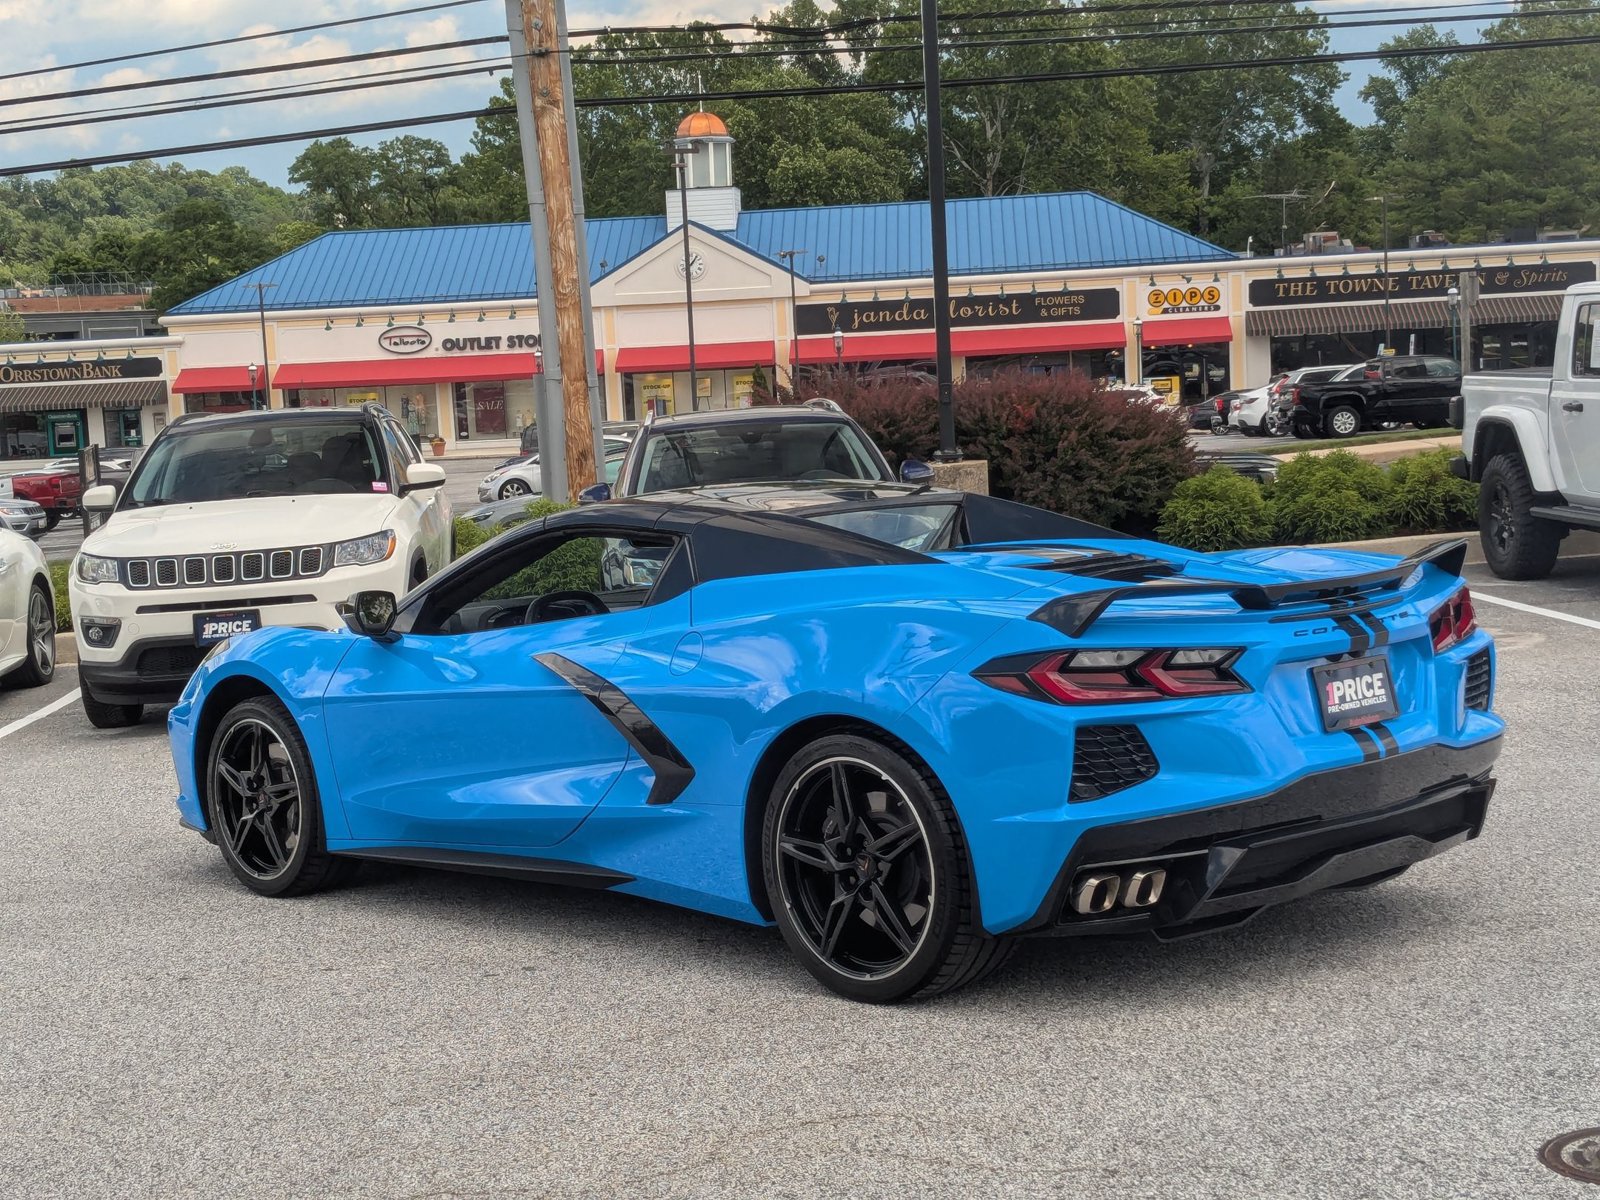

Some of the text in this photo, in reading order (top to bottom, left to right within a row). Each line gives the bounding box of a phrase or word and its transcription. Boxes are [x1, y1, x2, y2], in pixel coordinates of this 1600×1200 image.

[1275, 268, 1568, 297] THE TOWNE TAVEN & Spirits
[1035, 294, 1085, 306] FLOWERS
[1151, 288, 1217, 305] ZIPS
[852, 299, 1022, 329] janda lorist
[1040, 306, 1081, 317] & GIFTS
[1168, 305, 1215, 313] CLEANERS
[442, 336, 502, 351] OUTLET
[478, 400, 503, 410] SALE
[203, 620, 252, 635] 1PRICE
[1326, 673, 1386, 706] 1PRICE
[1328, 695, 1387, 714] PRE-OWNED VEHICLES
